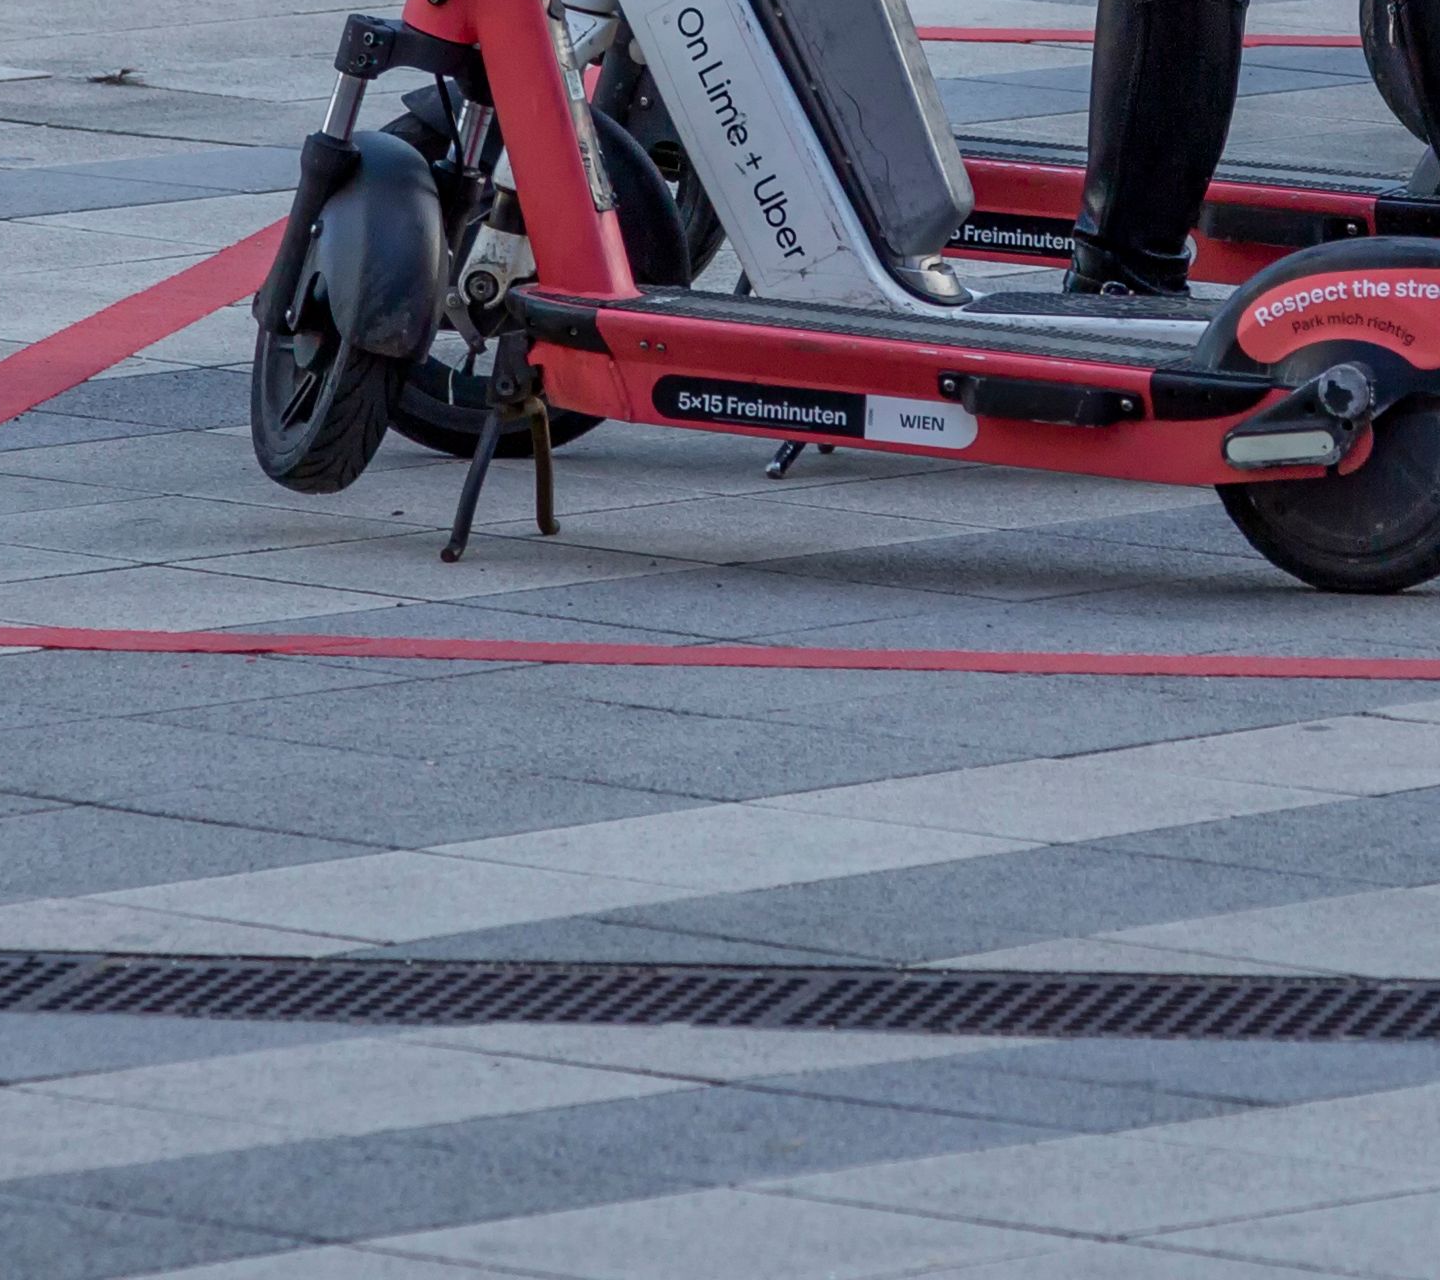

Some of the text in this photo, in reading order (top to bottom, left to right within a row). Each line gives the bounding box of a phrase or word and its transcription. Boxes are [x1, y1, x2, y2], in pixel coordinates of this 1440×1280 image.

[677, 7, 806, 259] On Lime + Uber
[964, 223, 1076, 251] Freiminuten
[1254, 282, 1348, 328] Respect
[1352, 278, 1392, 299] the
[1291, 311, 1417, 347] Park mich richtig
[726, 396, 848, 427] Freiminuten
[898, 412, 946, 433] WIEN
